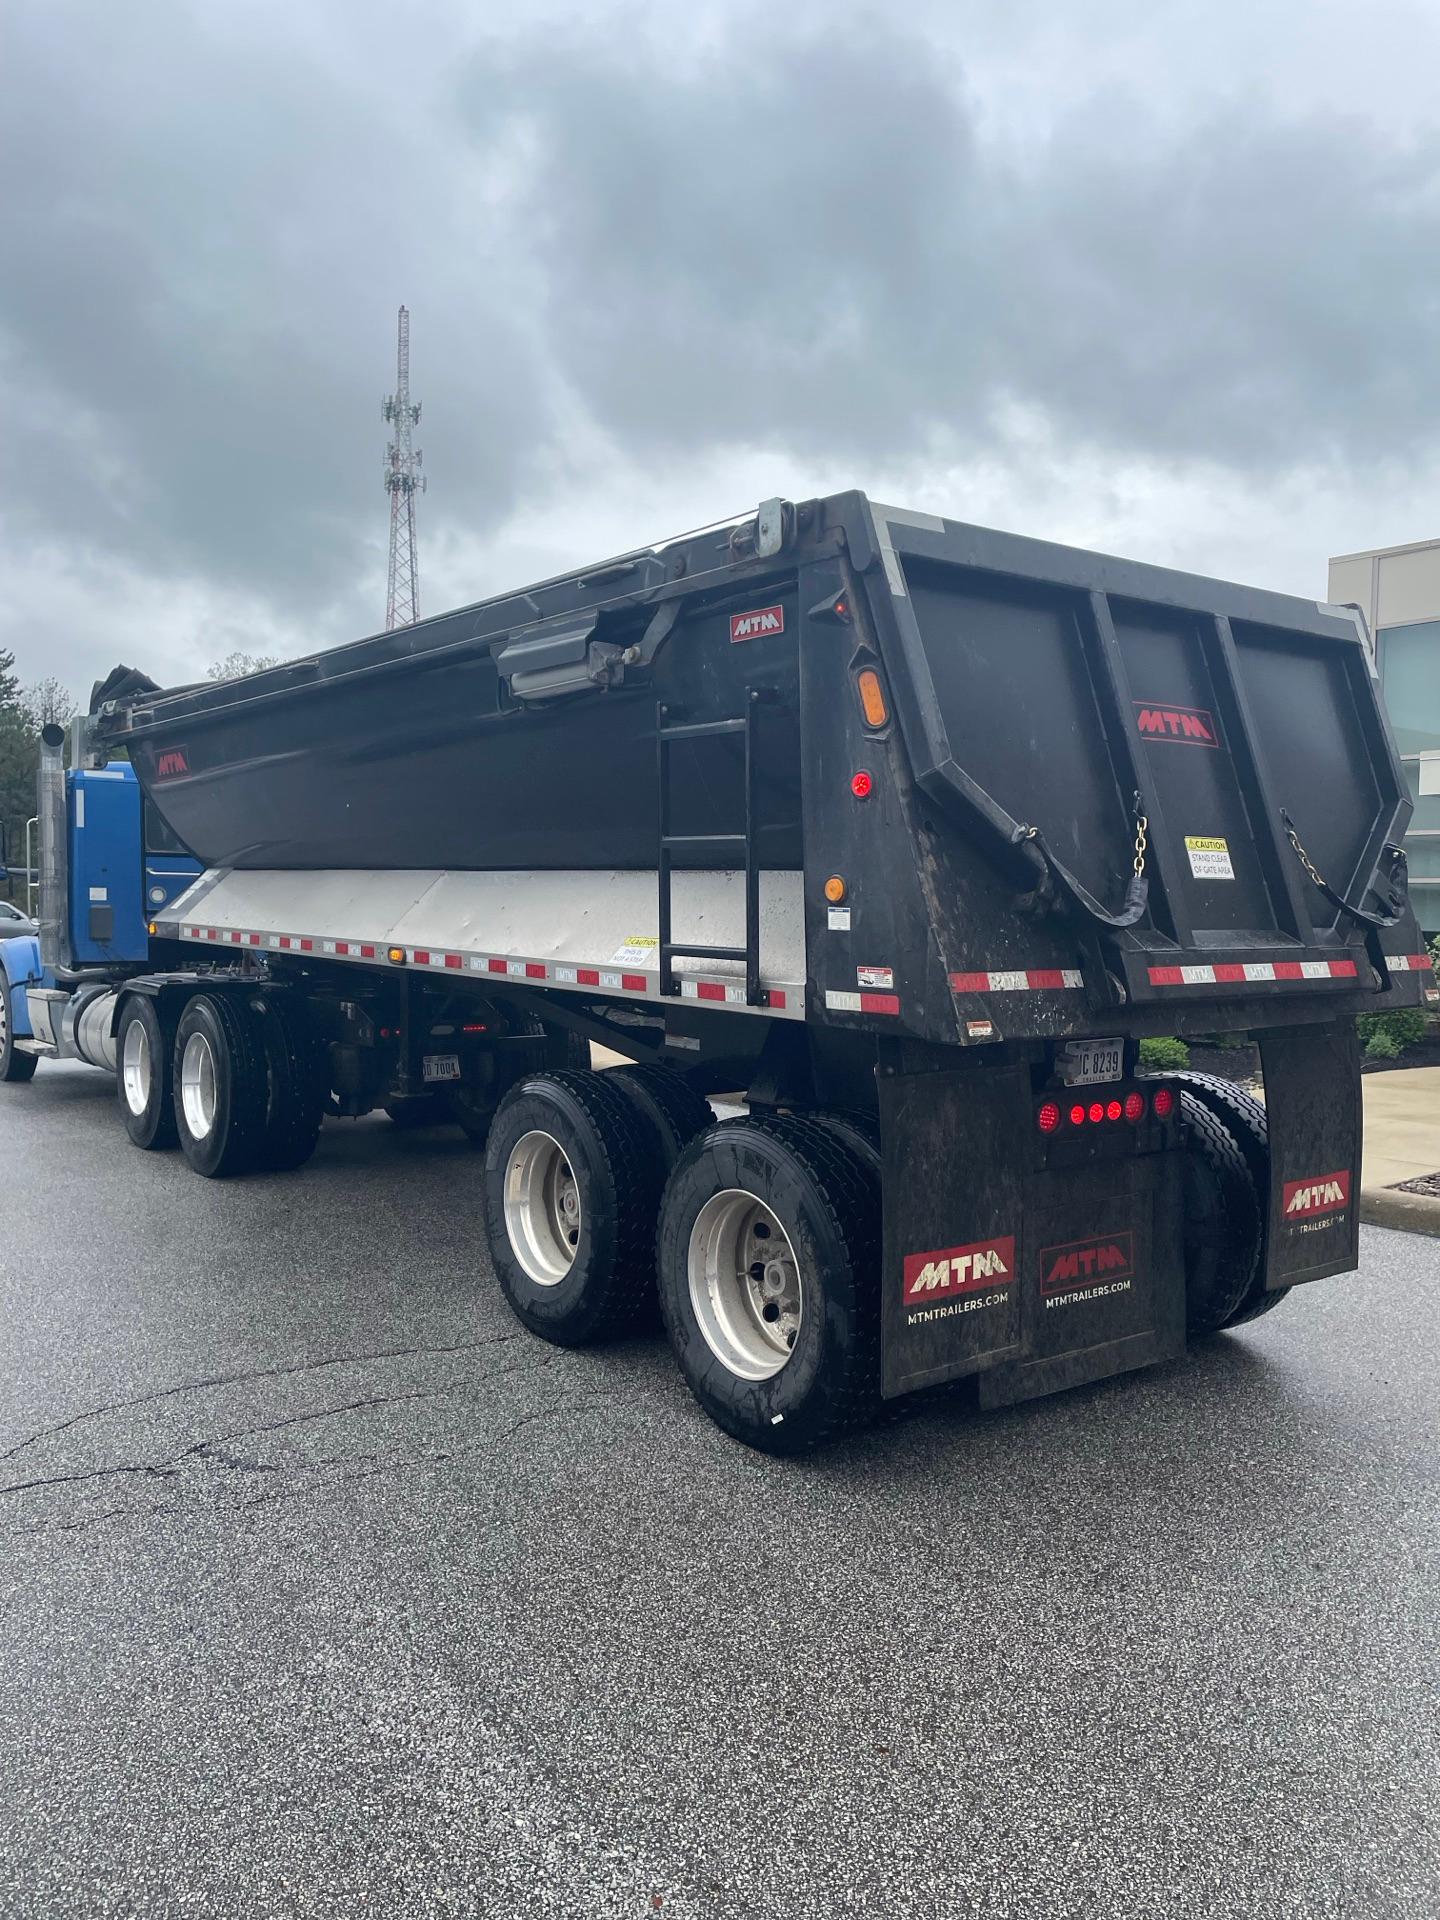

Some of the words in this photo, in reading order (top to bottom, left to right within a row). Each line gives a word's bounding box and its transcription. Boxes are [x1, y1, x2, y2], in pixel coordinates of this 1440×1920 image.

[734, 613, 780, 636] MTM
[1137, 709, 1213, 740] MTM
[158, 751, 188, 776] MTM
[1191, 853, 1211, 863] STAND
[1211, 854, 1228, 863] CLEAR
[1195, 841, 1226, 850] CAUTION
[1092, 1050, 1119, 1074] 8239
[1286, 1181, 1345, 1213] MTM
[909, 1250, 1008, 1294] MTM
[1047, 1244, 1128, 1282] MTM
[908, 1292, 1009, 1326] MTMTRAILERS.COM
[1046, 1280, 1131, 1309] MTMTRAILERS.COM
